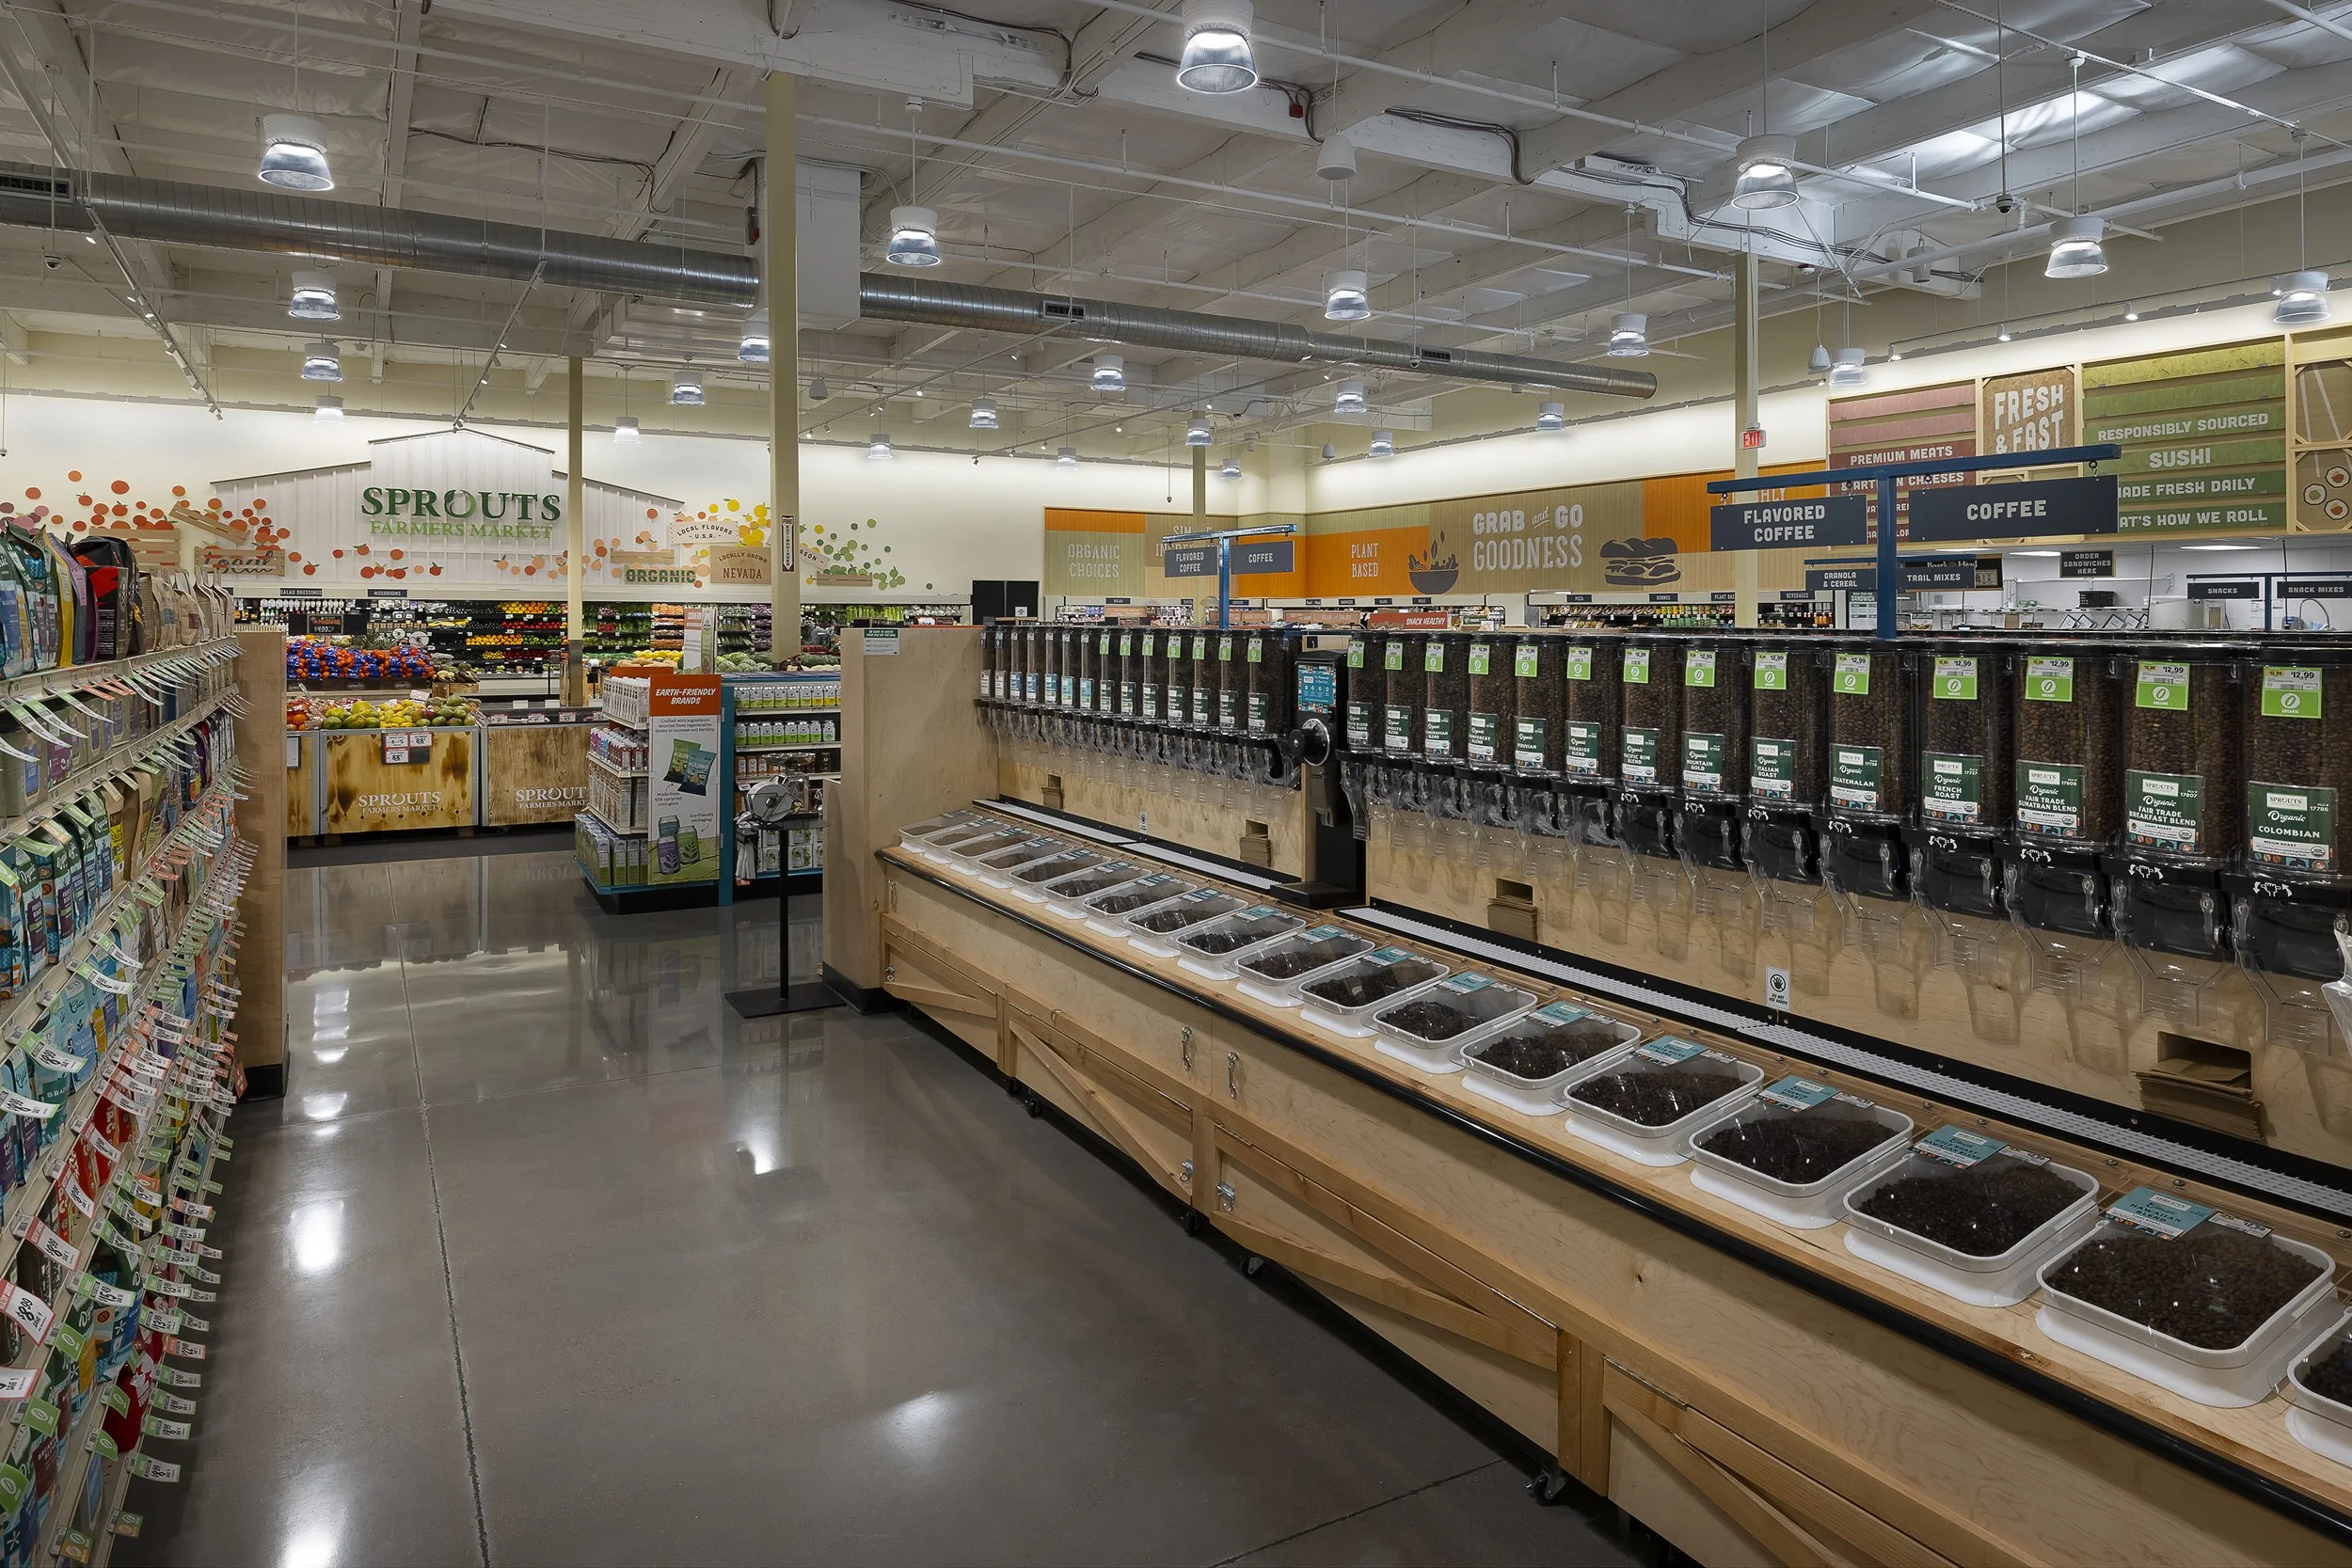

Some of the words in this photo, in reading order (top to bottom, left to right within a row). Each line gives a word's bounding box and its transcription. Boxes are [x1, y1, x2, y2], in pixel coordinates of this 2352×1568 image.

[1994, 385, 2064, 430] FRESH
[1995, 435, 2008, 454] &
[2013, 410, 2064, 451] FAST
[2098, 421, 2192, 441] RESPONSIBLY
[2198, 413, 2268, 432] SOURCED
[1743, 431, 1760, 449] EXIT
[1851, 450, 1905, 466] PREMIUM
[1910, 446, 1953, 460] MEATS
[2149, 448, 2211, 468] SUSHI
[1853, 476, 1903, 490] ARTN
[2119, 485, 2151, 499] ADE
[2156, 482, 2204, 495] FRESH
[2211, 478, 2255, 493] DAILY
[361, 486, 561, 521] SPROUTS
[1967, 500, 2047, 520] COFFEE
[1472, 510, 1525, 534] GRAB
[1533, 506, 1549, 529] and
[1554, 504, 1583, 529] GO
[1744, 505, 1825, 524] FLAVORED
[2120, 515, 2152, 528] AT'S
[2157, 513, 2191, 526] HOW
[2197, 512, 2220, 524] WE
[2226, 509, 2267, 523] ROLL
[371, 520, 464, 536] FARMERS
[470, 522, 552, 539] MARKET
[677, 525, 698, 536] LOCAL
[702, 525, 733, 535] FLAVORS
[1755, 525, 1814, 543] COFFEE
[719, 552, 745, 562] LOCALLY
[747, 552, 769, 563] GROWN
[800, 549, 817, 561] ASON
[1068, 545, 1120, 559] ORGANIC
[1176, 552, 1204, 562] FLAVORED
[1351, 543, 1378, 559] PLANT
[1473, 535, 1582, 572] GOODNESS
[203, 551, 275, 574] Local
[1248, 553, 1273, 563] COFFEE
[723, 568, 762, 578] NEVADA
[1070, 563, 1119, 578] CHOICES
[1180, 563, 1200, 572] COFFEE
[1352, 562, 1378, 578] BASED
[626, 569, 696, 583] ORGANIC
[2318, 585, 2344, 594] MIXES
[1422, 617, 1445, 626] HEALTHY
[2291, 671, 2314, 679] $12.99
[1689, 751, 1708, 759] Organic
[1757, 756, 1777, 765] Organic
[1839, 765, 1863, 774] Organic
[1833, 777, 1874, 786] GUATEMALAN
[1934, 774, 1962, 784] Organic
[516, 786, 587, 802] SPROUT
[1934, 785, 1963, 794] FRENCH
[2029, 784, 2059, 796] Organic
[358, 791, 440, 807] SPROUTS
[2018, 800, 2050, 810] SUMATRAN
[2042, 797, 2065, 805] TRADE
[2143, 796, 2177, 807] Organic
[2269, 796, 2302, 804] SPROUTS
[362, 806, 401, 815] FARMERS
[403, 804, 437, 813] MARKET
[2138, 806, 2153, 815] FAIR
[2156, 809, 2183, 818] TRADE
[2129, 811, 2168, 823] BREAKFAST
[2170, 817, 2197, 826] BLEND
[2267, 810, 2306, 823] Organic
[2258, 826, 2320, 838] COLOMBIAN
[2154, 1196, 2186, 1209] SPROUTS
[2130, 1203, 2182, 1223] HAWAIIAN
[2136, 1210, 2167, 1222] BLEND
